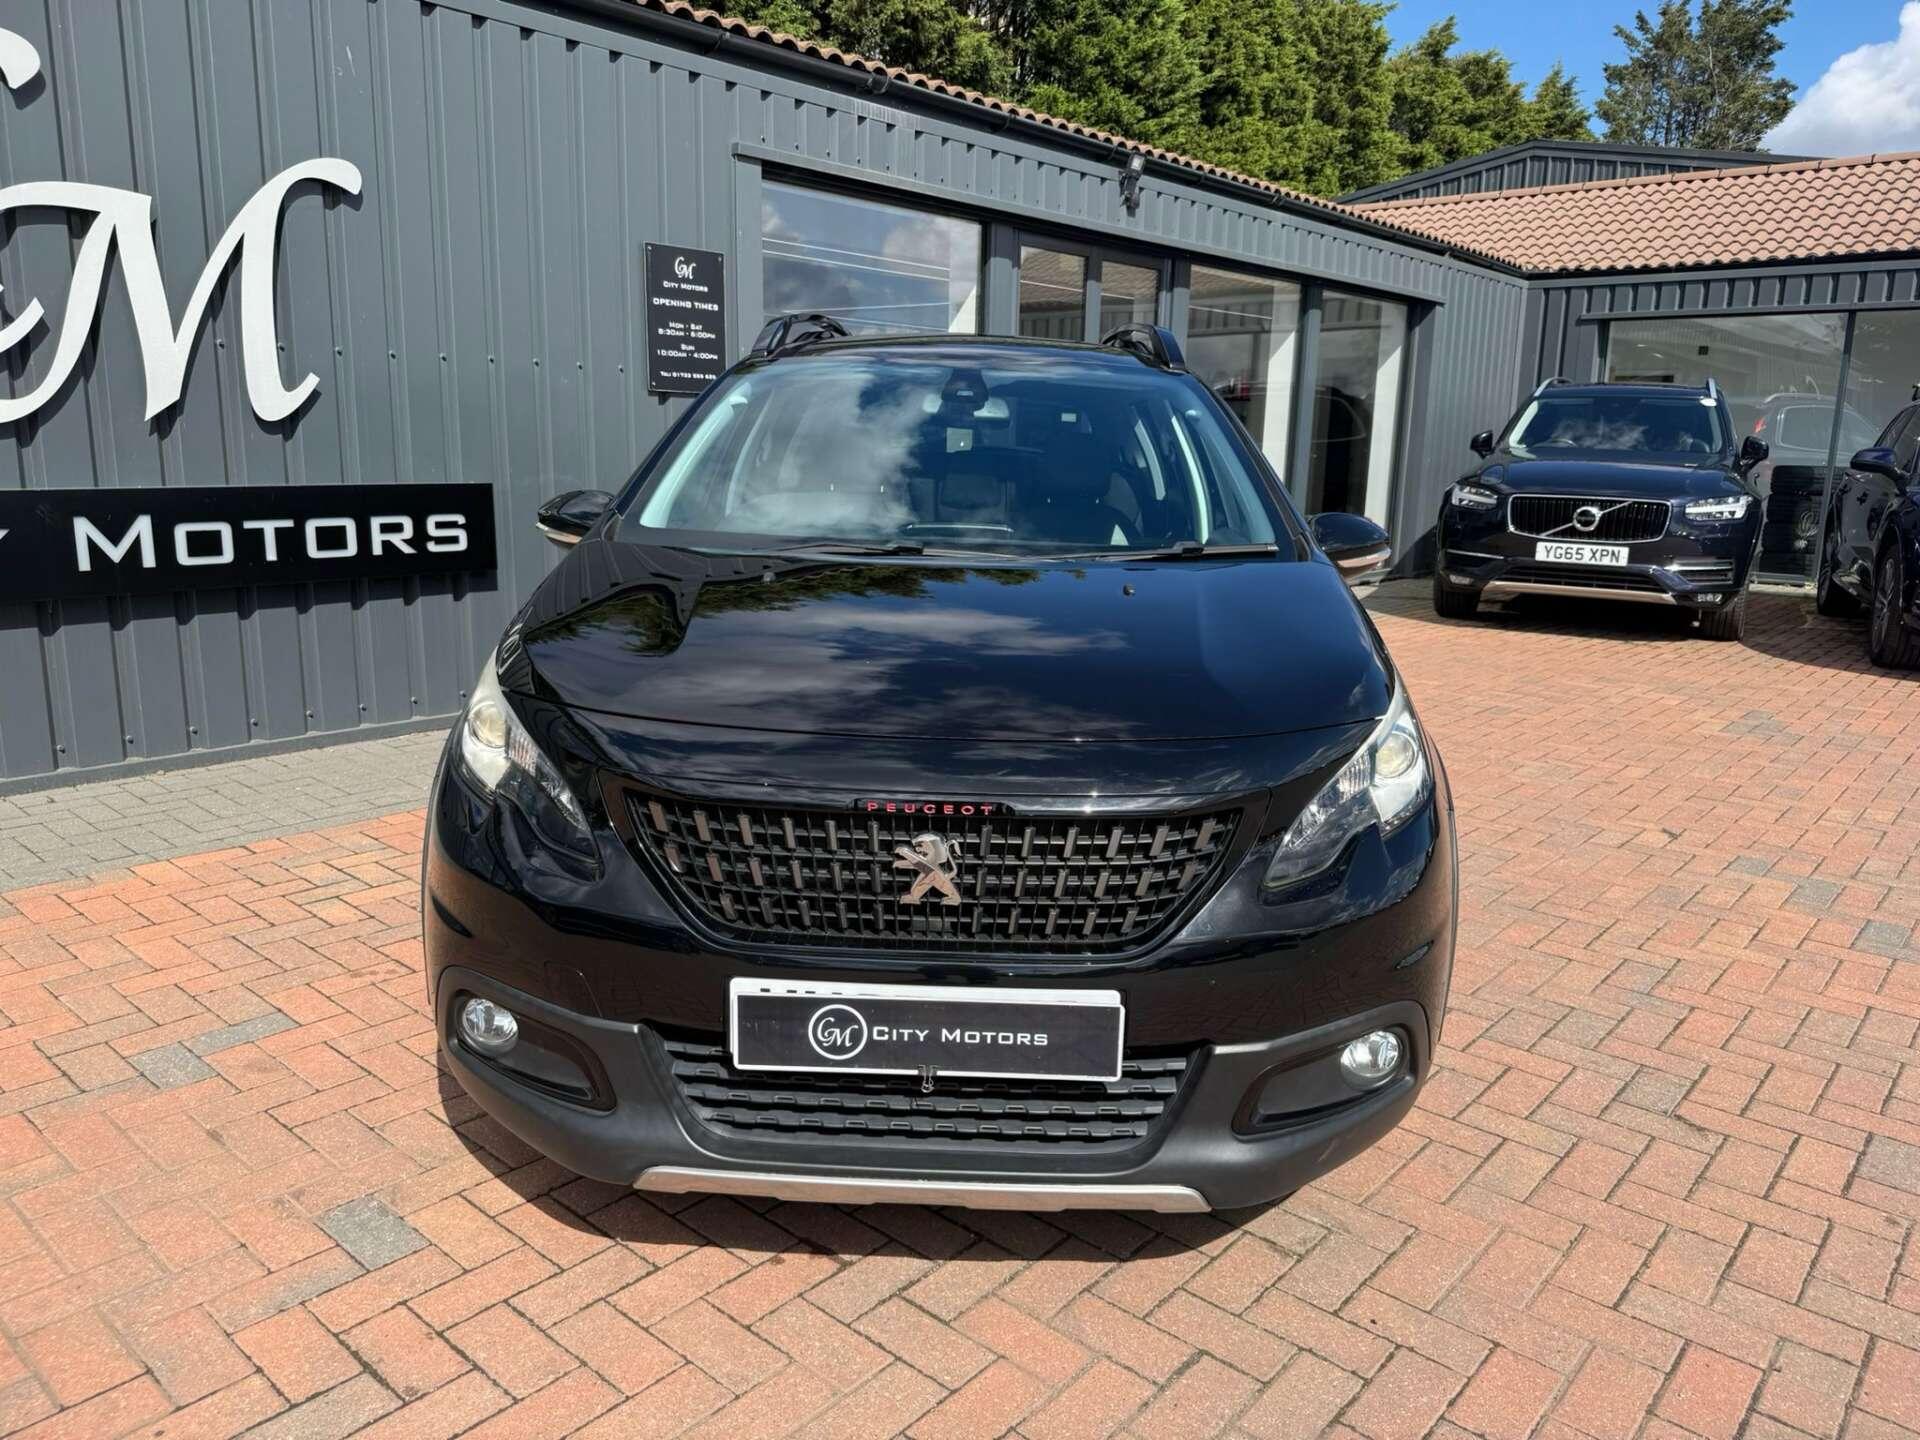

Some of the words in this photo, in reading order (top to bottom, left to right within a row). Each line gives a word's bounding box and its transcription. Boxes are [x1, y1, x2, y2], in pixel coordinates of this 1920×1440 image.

[653, 298, 692, 308] OPENING
[694, 302, 718, 311] TIMES
[72, 513, 470, 572] MOTORS
[1544, 545, 1585, 561] YG65
[1588, 548, 1621, 563] XPN
[866, 801, 993, 816] PEUGEOT
[941, 1027, 1049, 1046] MOTORS
